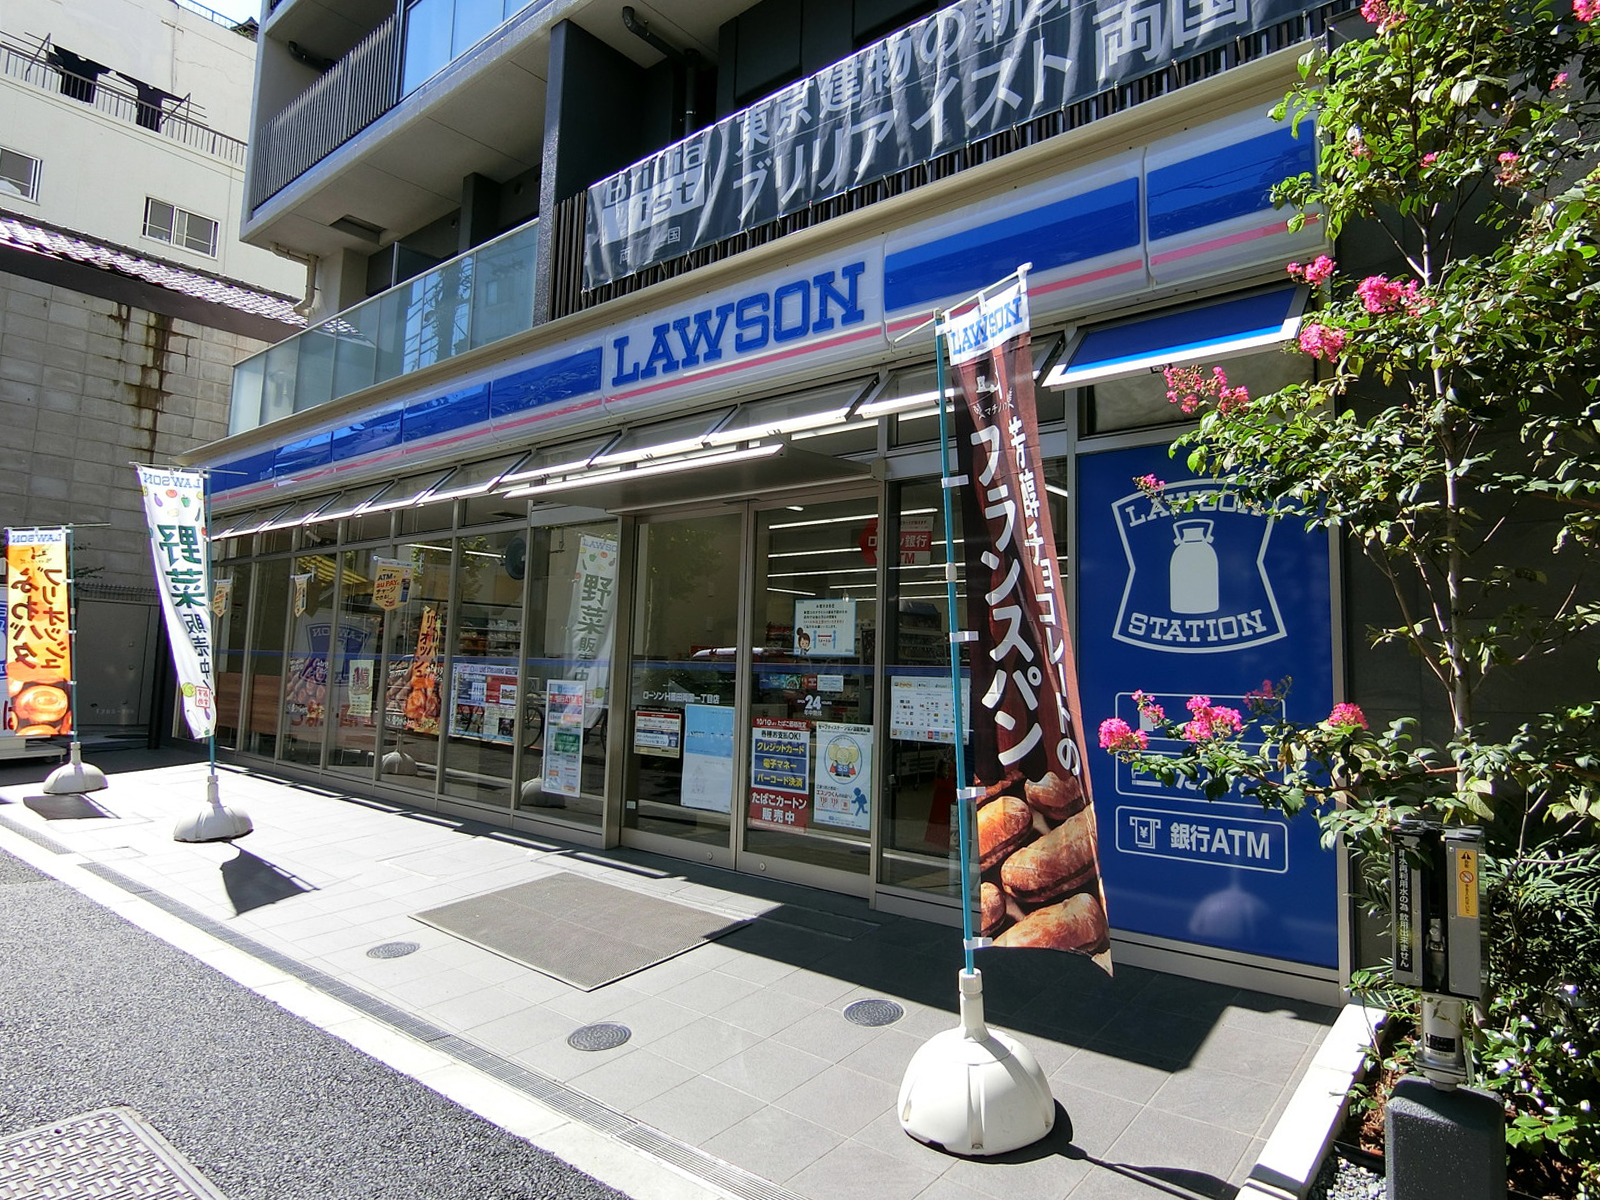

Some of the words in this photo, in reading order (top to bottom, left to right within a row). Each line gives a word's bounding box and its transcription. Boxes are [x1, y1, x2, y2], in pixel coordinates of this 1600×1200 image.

[612, 261, 865, 387] LAWSON
[950, 297, 1023, 356] LAWSON
[970, 424, 1043, 767] フランスパン
[1008, 415, 1083, 777] 芳醇チョコレートの
[1128, 608, 1267, 642] STATION
[805, 694, 822, 710] 24
[757, 742, 805, 755] クレジットカード
[763, 758, 797, 769] 電子マネー
[751, 792, 807, 810] たばこカートン
[762, 807, 795, 825] 販売中
[1170, 821, 1270, 860] 銀行ATM
